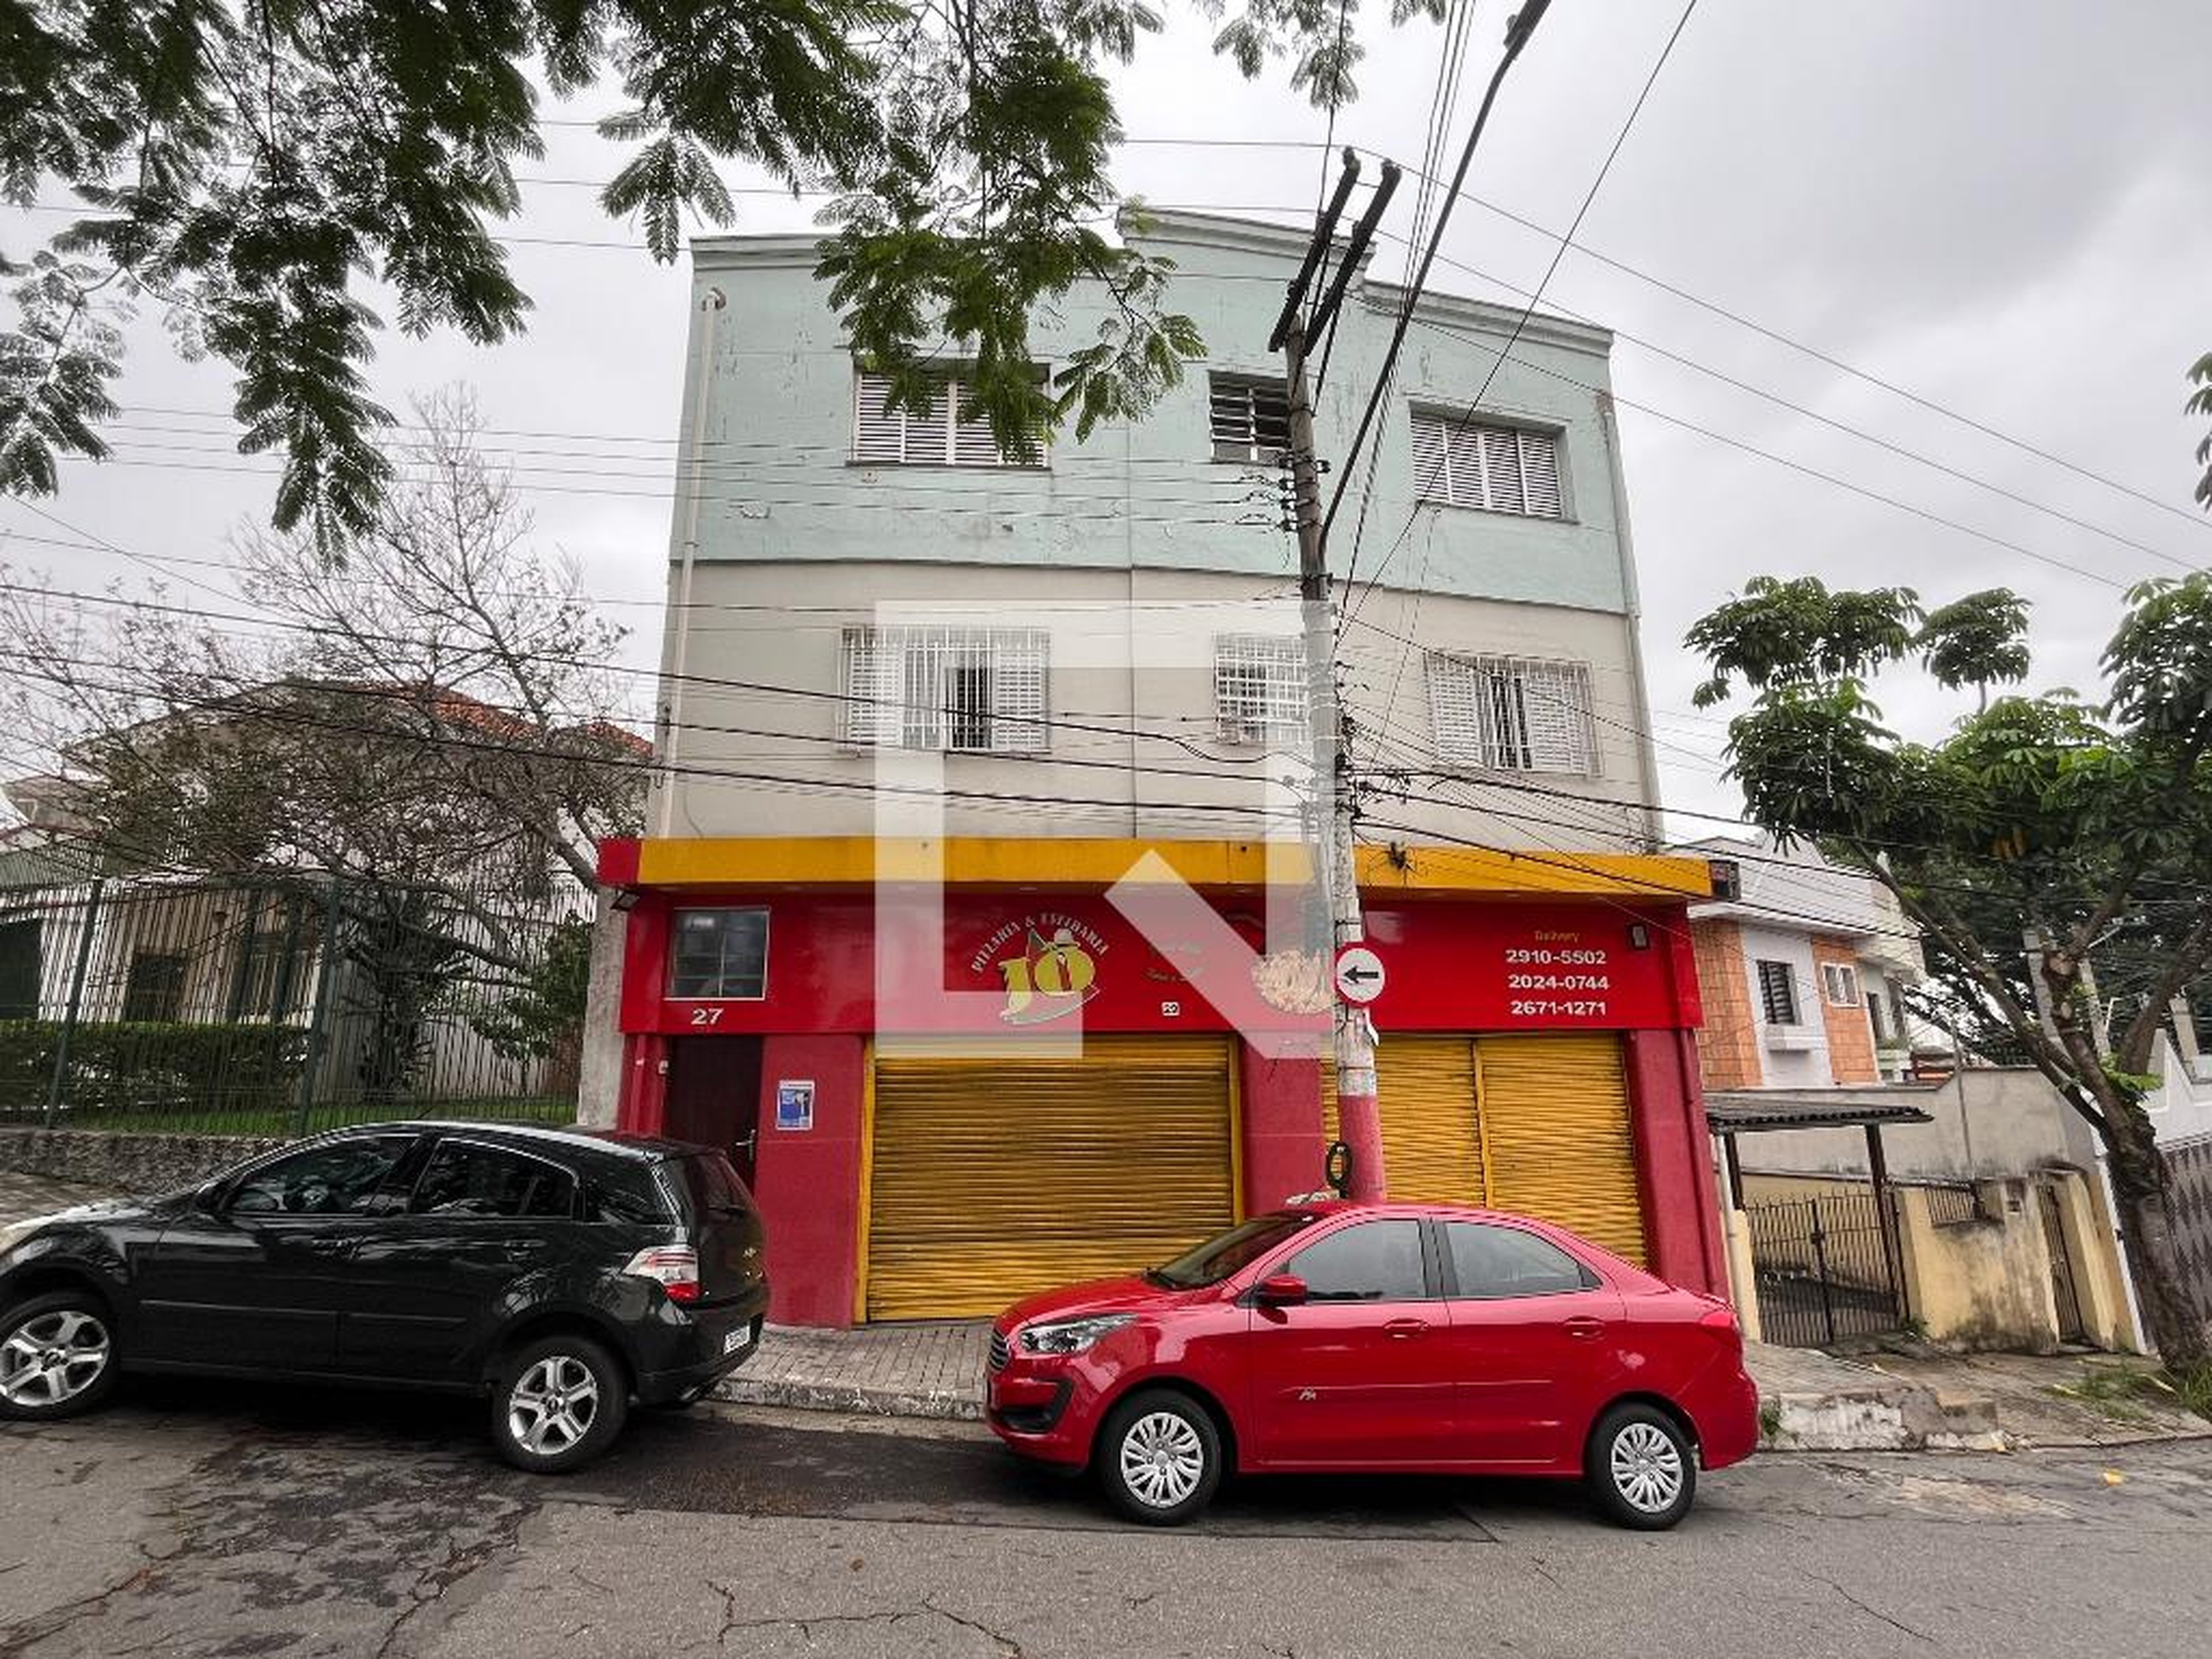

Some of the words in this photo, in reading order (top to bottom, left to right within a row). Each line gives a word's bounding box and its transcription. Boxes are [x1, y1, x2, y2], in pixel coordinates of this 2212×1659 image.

[1505, 949, 1606, 964] 2910-5502
[1508, 975, 1609, 990] 2024-0744
[1510, 1001, 1606, 1016] 2671-1271
[691, 1008, 724, 1025] 27
